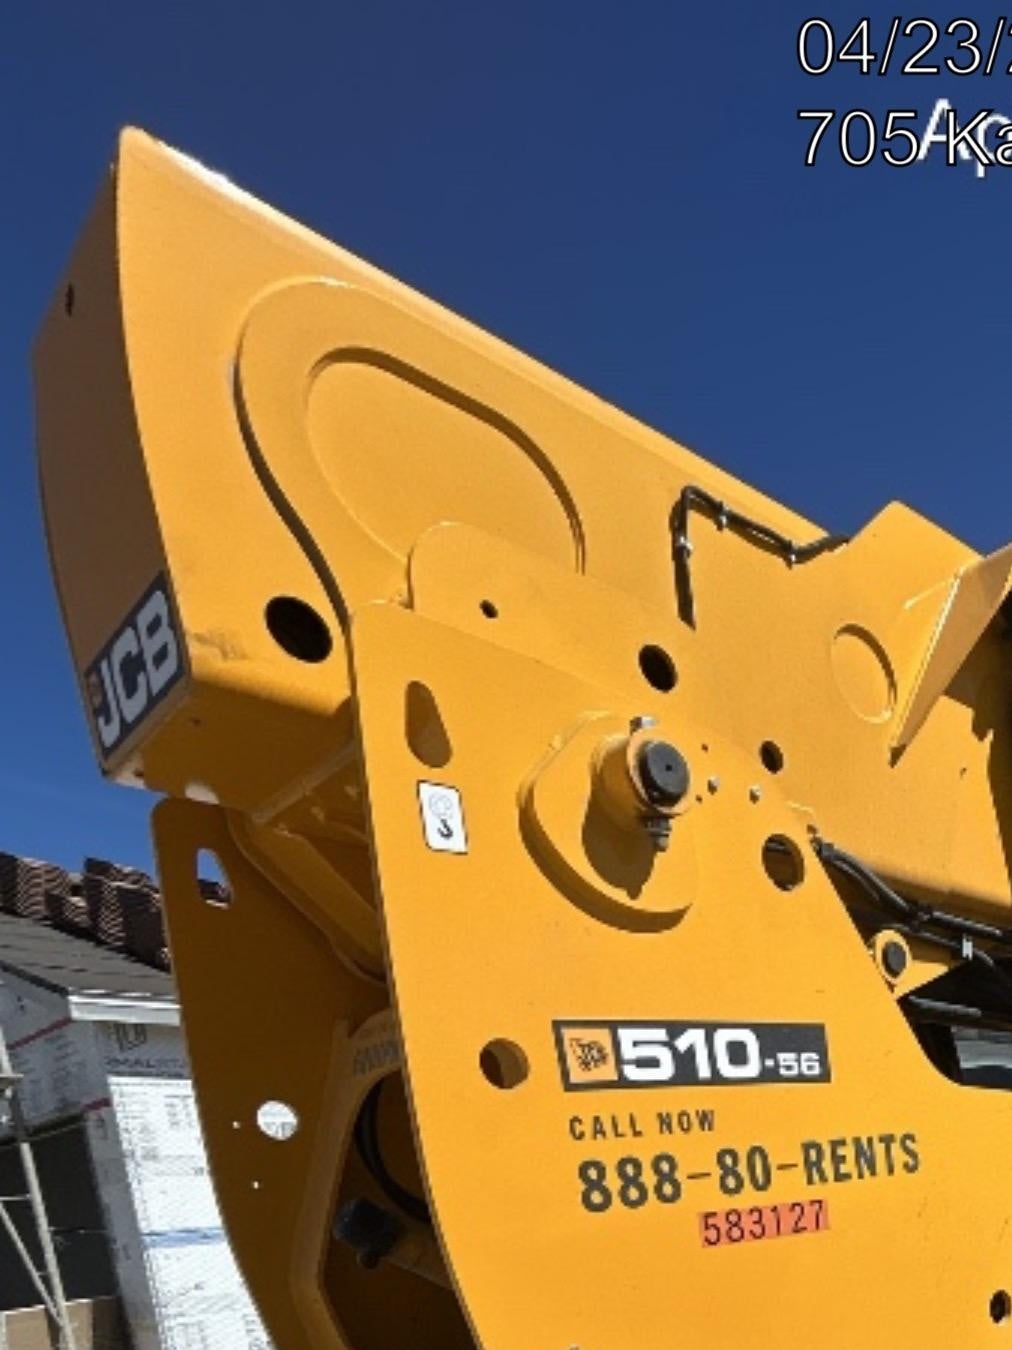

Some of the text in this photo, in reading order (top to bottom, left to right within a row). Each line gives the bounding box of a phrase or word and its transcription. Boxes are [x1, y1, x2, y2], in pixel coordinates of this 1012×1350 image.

[98, 590, 179, 748] JCB
[617, 1027, 822, 1082] 510-56
[569, 1109, 716, 1141] CALL NOW
[577, 1133, 920, 1213] 888-80-RENTS
[702, 1201, 825, 1247] 583127
